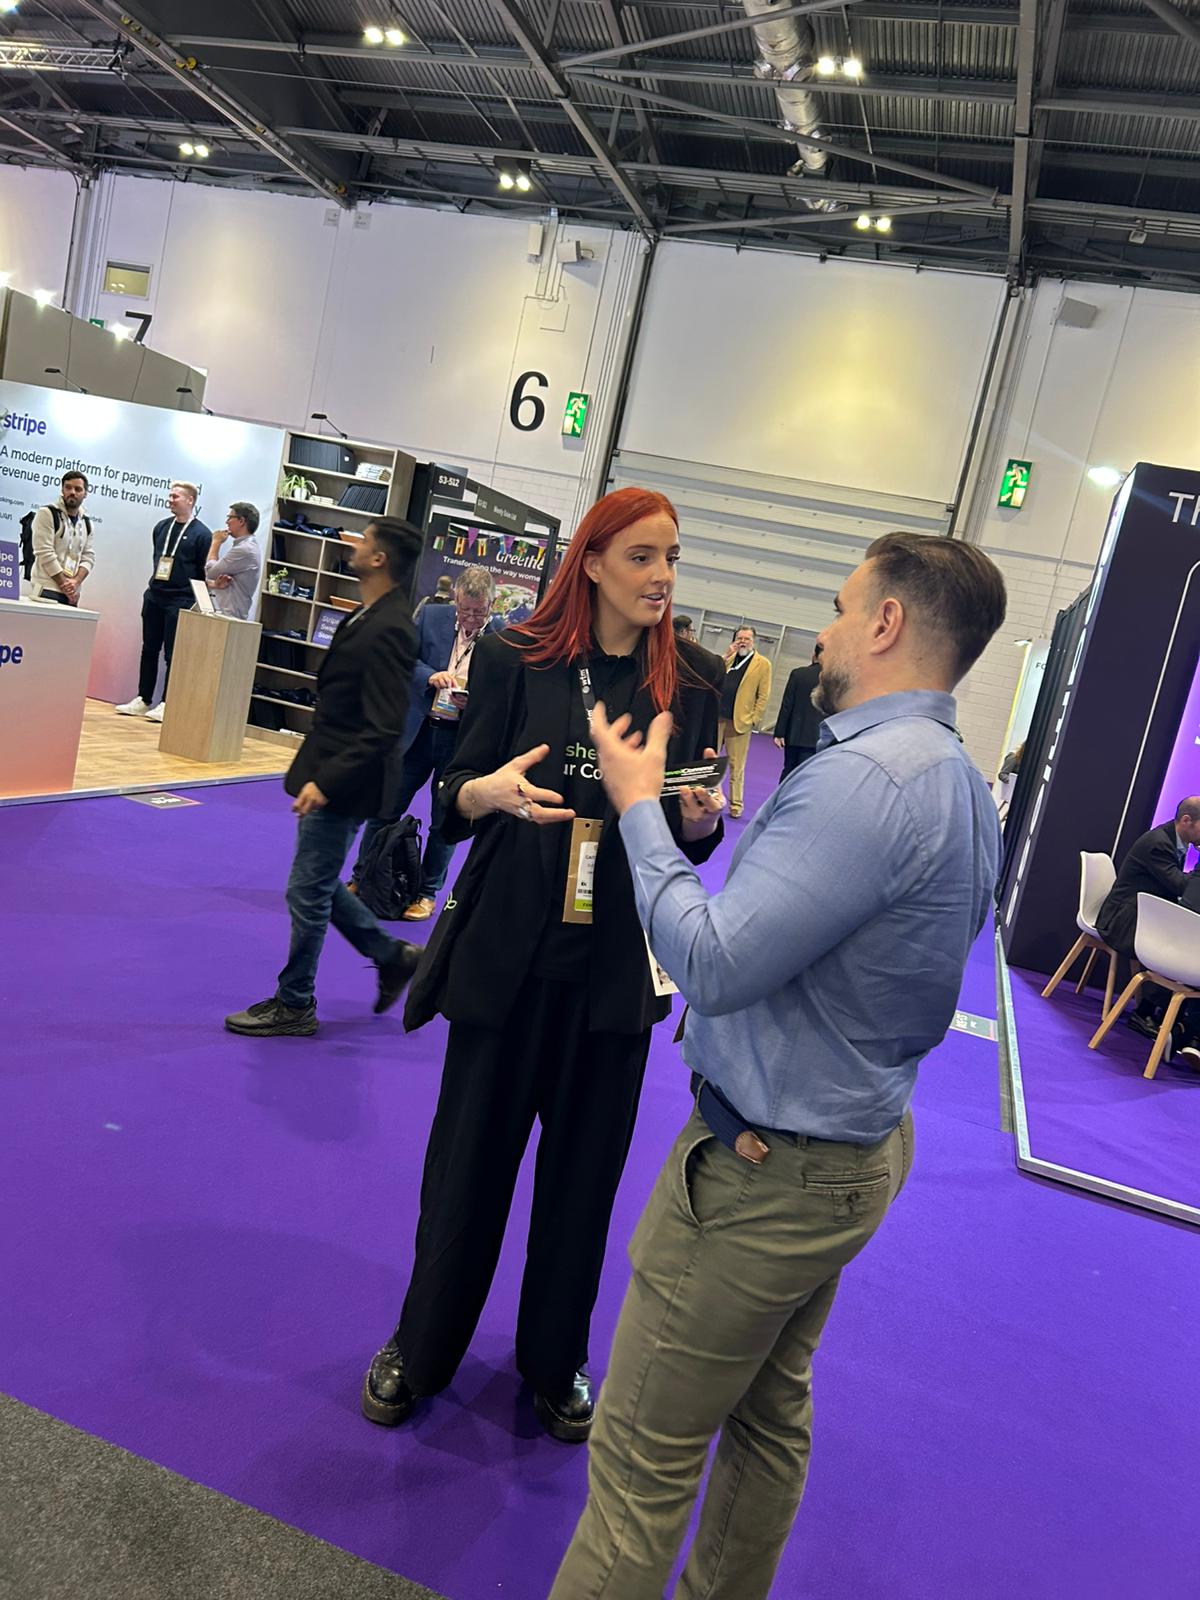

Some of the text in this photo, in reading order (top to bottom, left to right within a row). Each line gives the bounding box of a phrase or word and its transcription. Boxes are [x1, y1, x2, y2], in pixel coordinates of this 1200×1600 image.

[125, 311, 152, 344] 7
[510, 371, 549, 431] 6
[4, 413, 47, 435] stripe
[0, 445, 171, 490] A modern platform for payment
[0, 465, 40, 482] revenue
[101, 485, 118, 497] the
[121, 489, 152, 505] travel
[490, 566, 502, 574] the
[503, 569, 518, 578] way
